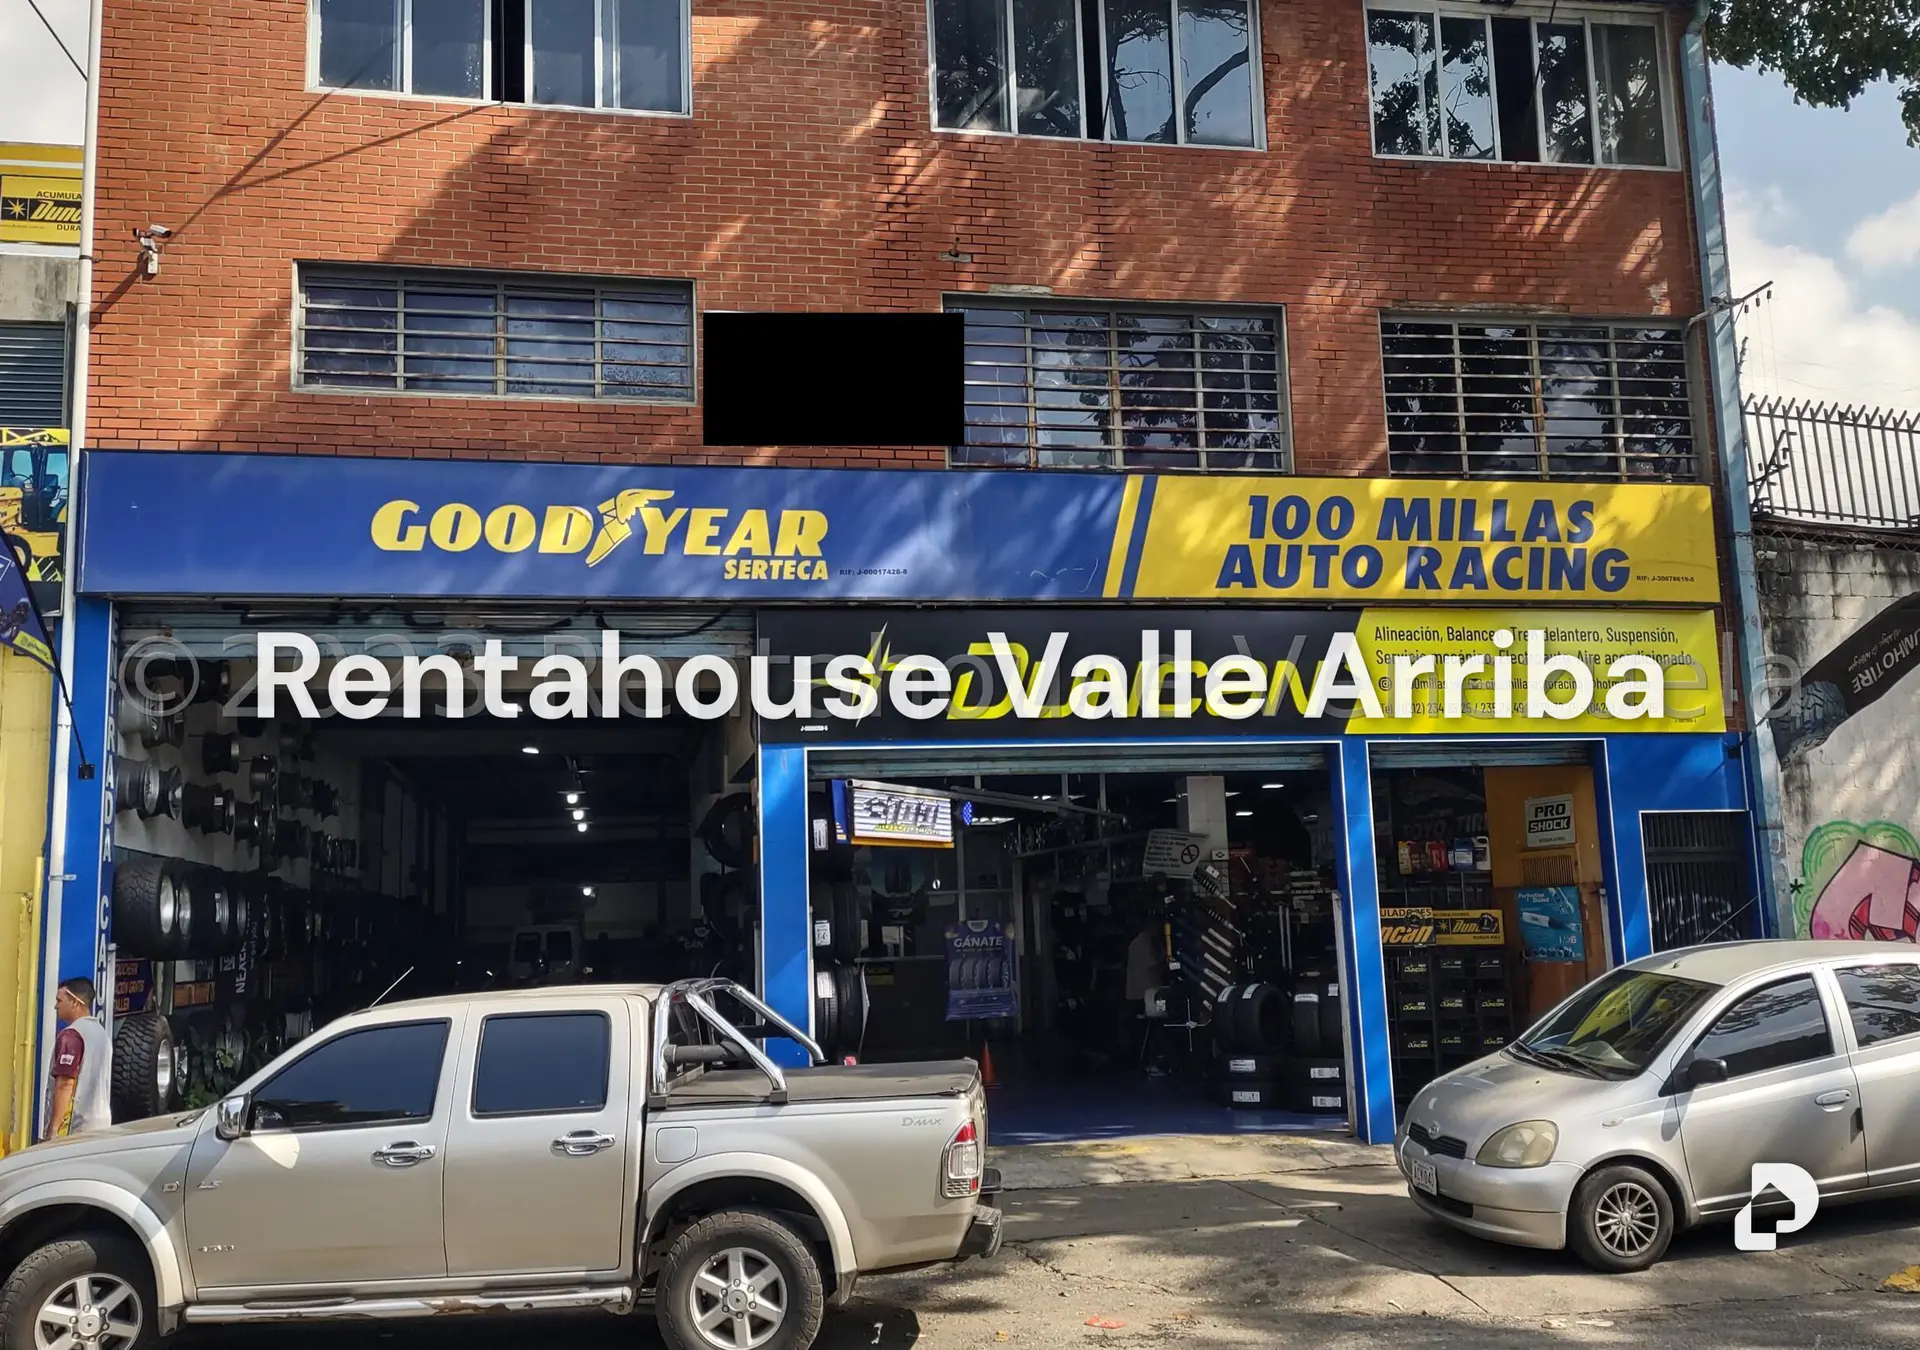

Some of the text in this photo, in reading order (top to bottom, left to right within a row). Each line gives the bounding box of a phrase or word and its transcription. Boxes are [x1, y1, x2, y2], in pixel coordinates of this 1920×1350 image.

[36, 191, 82, 200] ACUMULA
[1248, 494, 1596, 543] 100 MILLAS
[723, 558, 829, 581] SERTECA
[1215, 543, 1630, 593] AUTO RACING
[1374, 626, 1443, 643] Alineación,
[1606, 627, 1679, 646] Suspensión,
[1851, 662, 1885, 694] TIRE
[102, 606, 120, 863] ENTRADA
[1534, 803, 1567, 819] PRO
[1530, 818, 1570, 833] SHOCK
[953, 935, 1003, 948] GÁNATE
